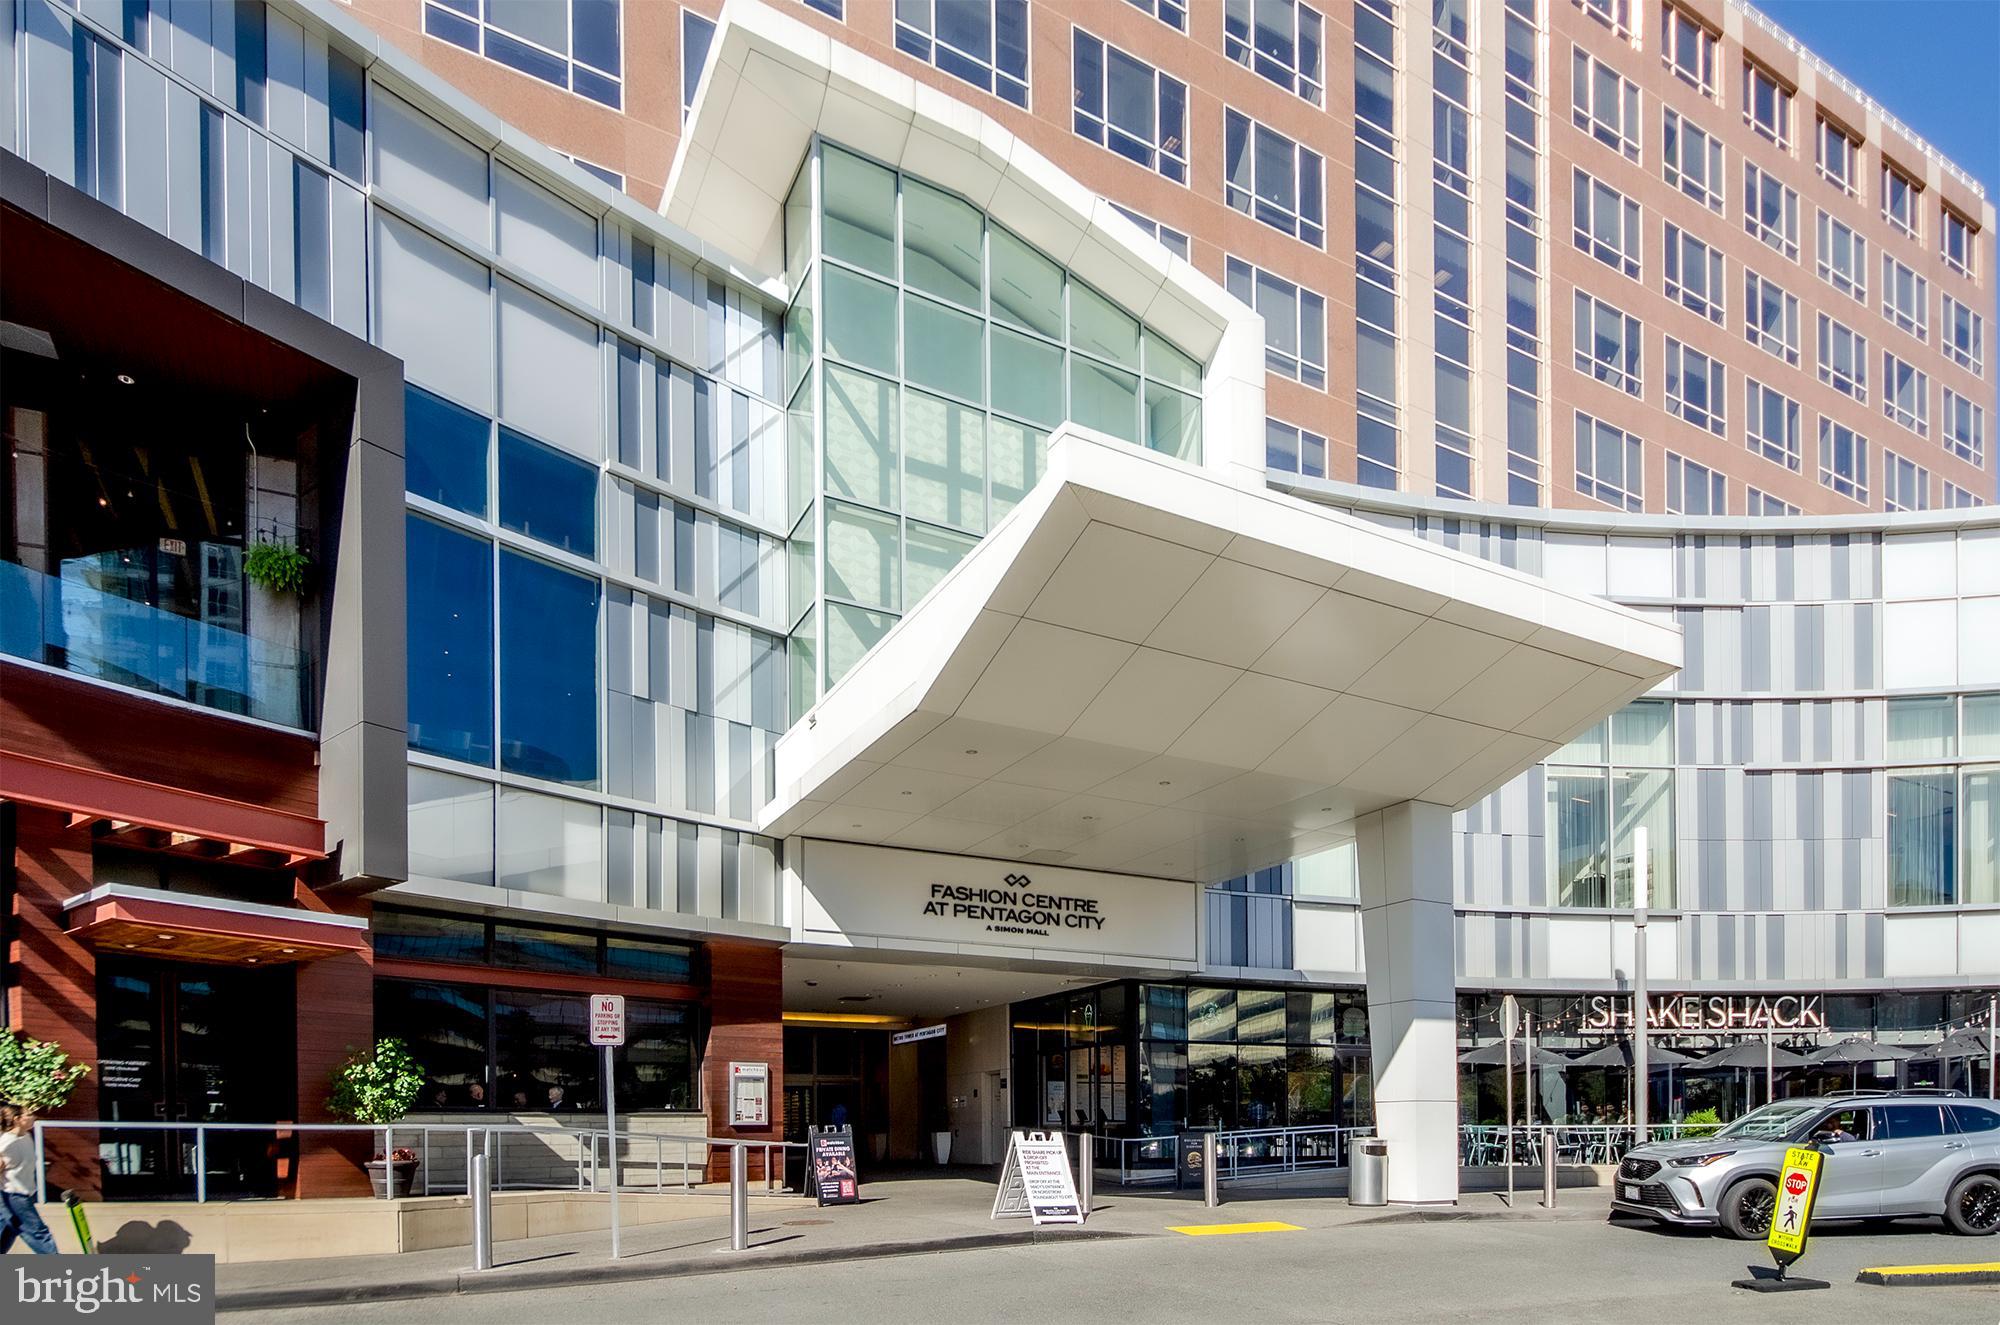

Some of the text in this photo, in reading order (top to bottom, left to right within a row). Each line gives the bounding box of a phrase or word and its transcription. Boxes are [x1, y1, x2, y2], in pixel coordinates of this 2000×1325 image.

[931, 883, 1099, 914] FASHION CENTRE
[923, 901, 1106, 930] AT PENTAGON CITY
[994, 926, 1024, 934] SIMON
[1026, 928, 1050, 936] MALL
[601, 1001, 614, 1012] NO
[1706, 995, 1821, 1028] SHACK
[1791, 1151, 1815, 1161] STATE
[1786, 1179, 1807, 1190] STOP
[1778, 1234, 1794, 1242] WITHIN
[1771, 1239, 1798, 1249] CROSSWALK
